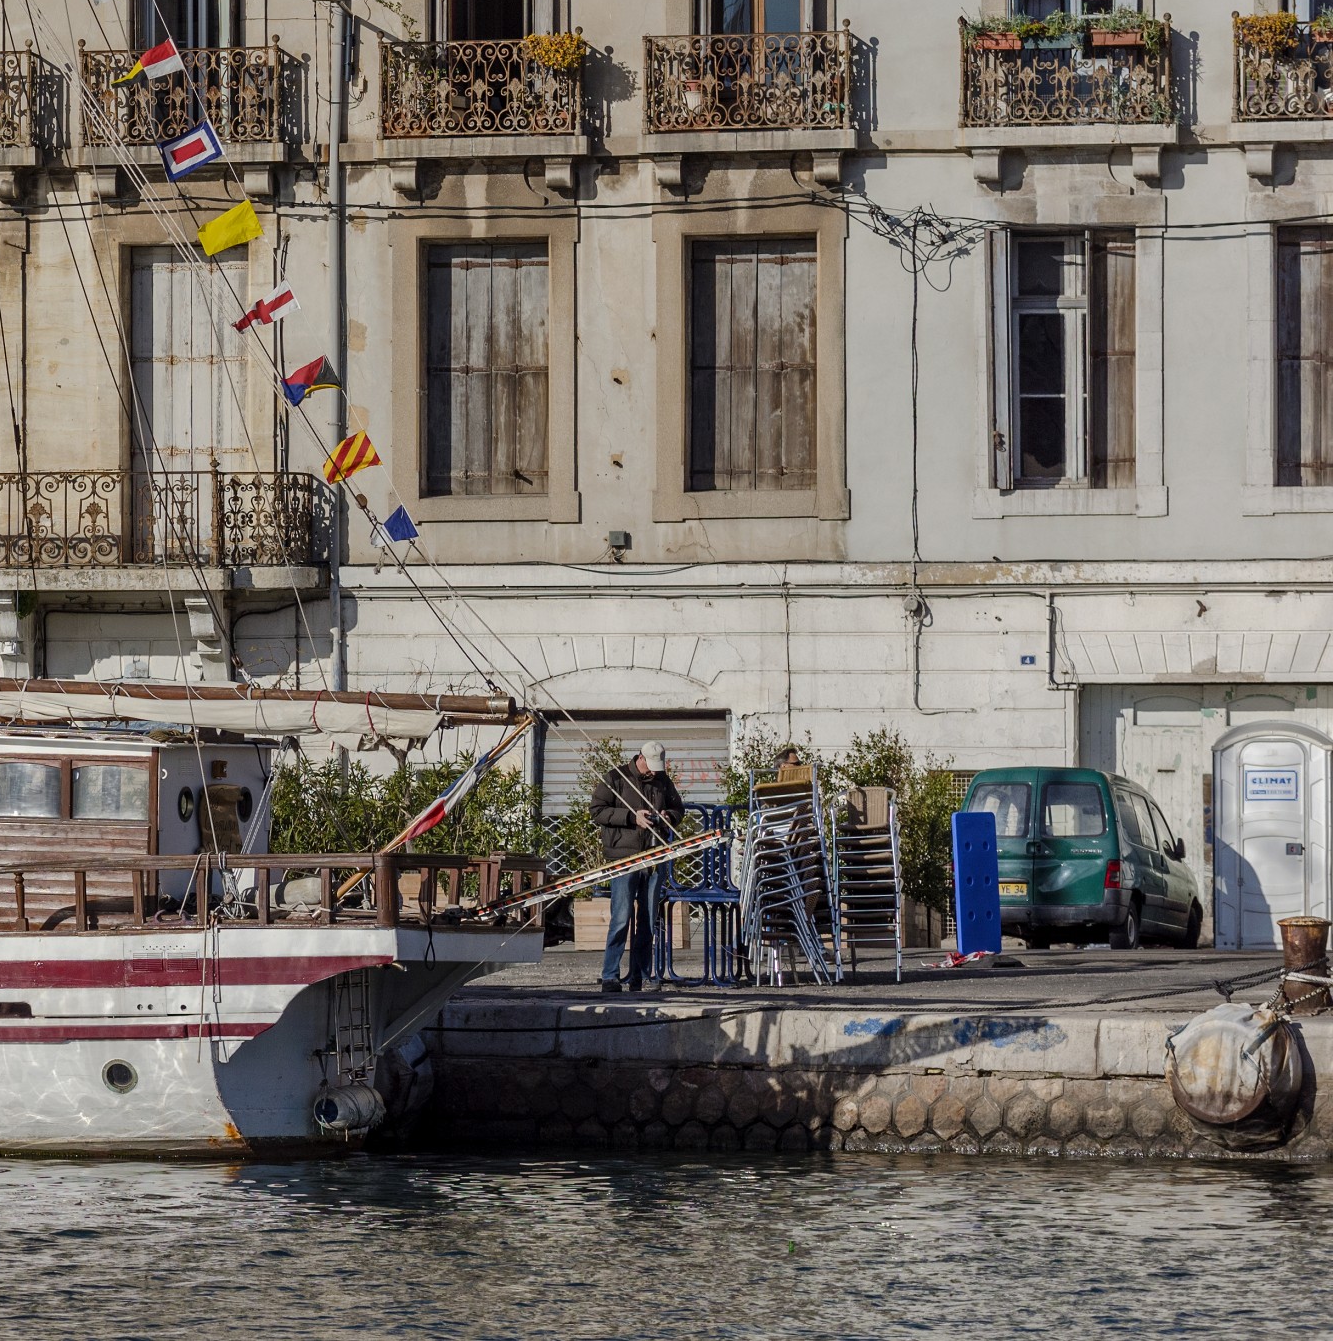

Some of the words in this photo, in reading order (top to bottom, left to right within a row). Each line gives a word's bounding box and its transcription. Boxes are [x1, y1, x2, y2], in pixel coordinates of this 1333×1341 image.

[1251, 777, 1292, 785] CLIMAT
[1001, 884, 1011, 894] YE
[1014, 884, 1024, 894] 34
